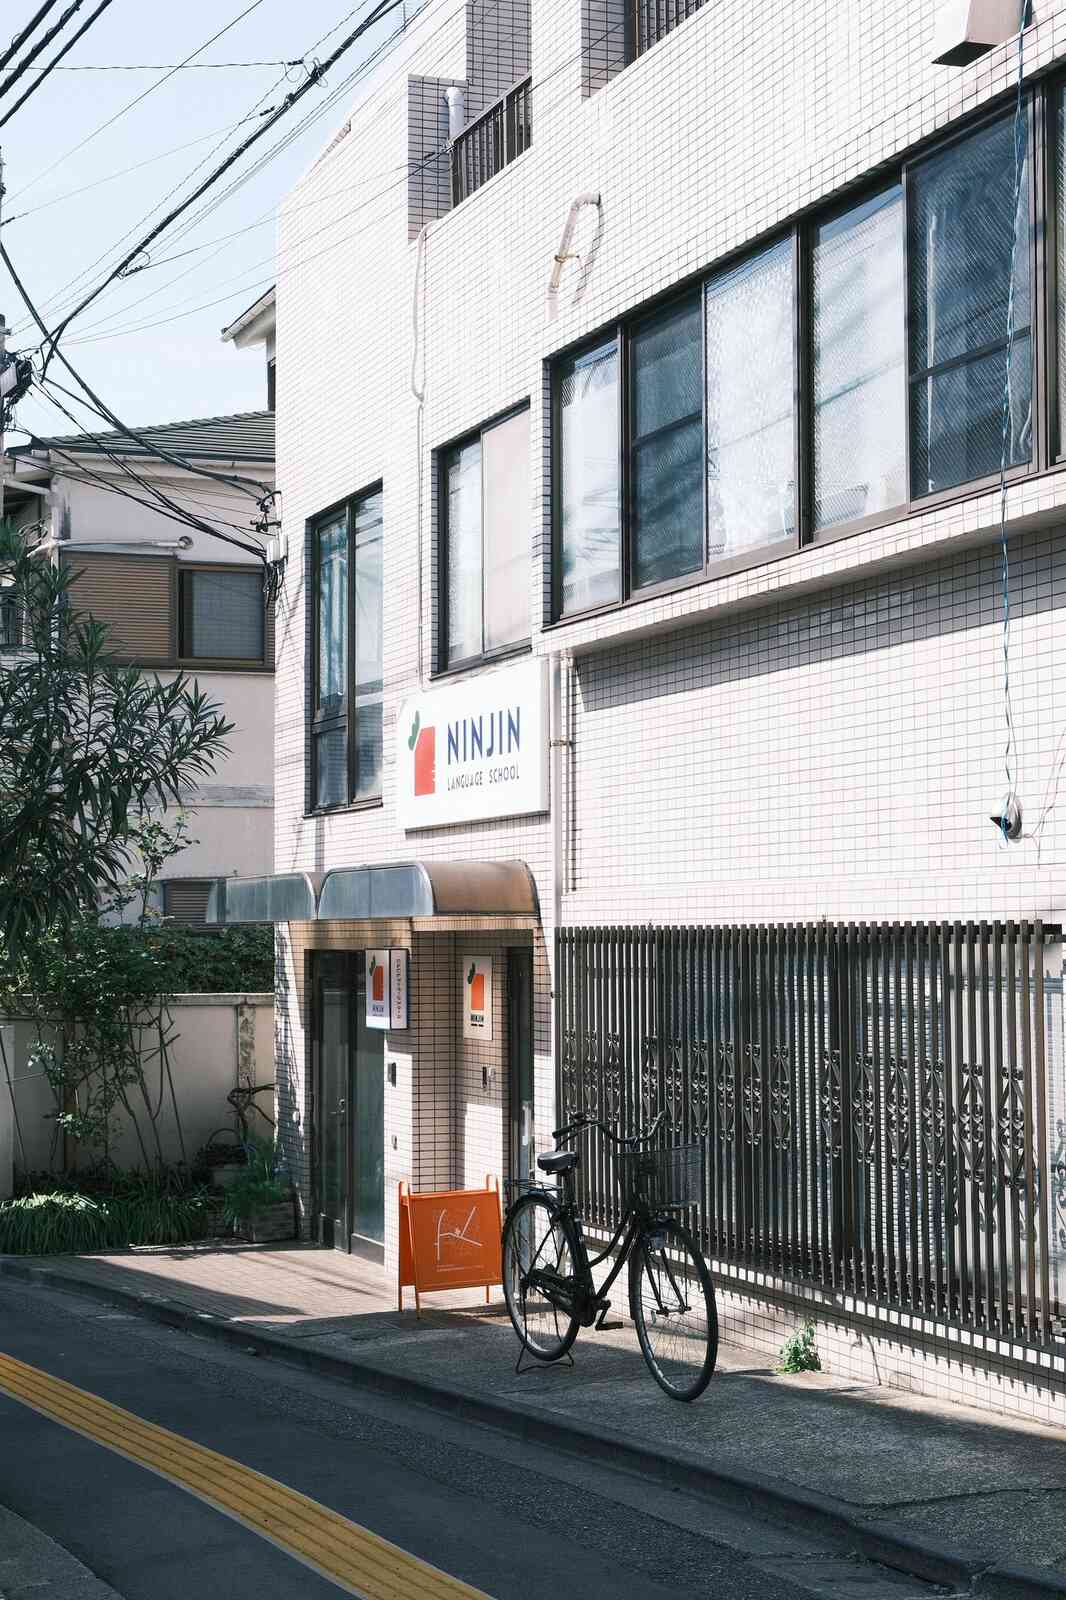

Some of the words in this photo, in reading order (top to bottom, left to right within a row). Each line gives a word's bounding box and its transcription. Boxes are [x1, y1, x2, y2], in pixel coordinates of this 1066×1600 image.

[447, 706, 521, 765] NINJIN
[447, 770, 483, 791] LANGUAGE
[489, 765, 520, 784] SCHOOL
